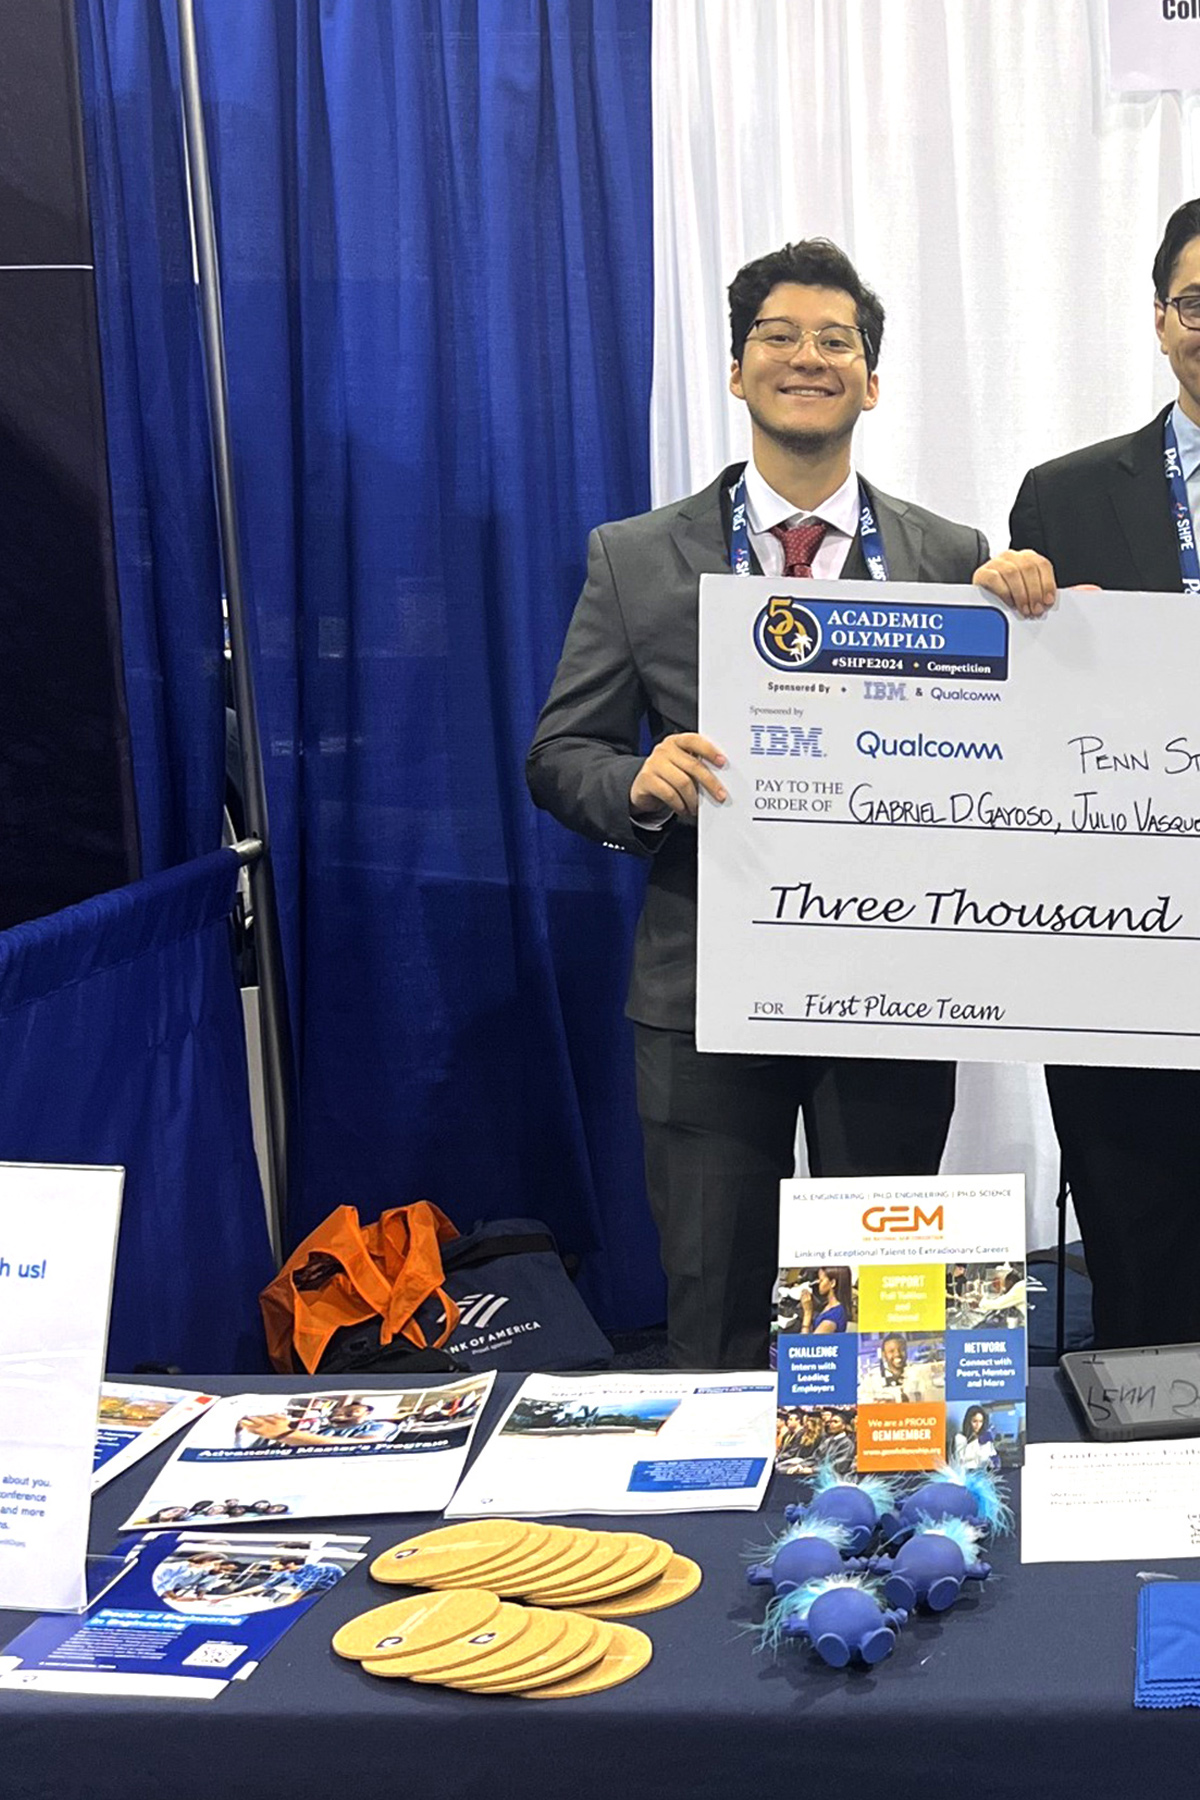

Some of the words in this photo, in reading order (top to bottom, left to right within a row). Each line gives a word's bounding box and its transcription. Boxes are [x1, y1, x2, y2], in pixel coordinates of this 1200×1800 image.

[1177, 519, 1194, 550] SHPE
[827, 610, 944, 630] ACADEMIC
[831, 630, 946, 650] OLYMPIAD
[831, 657, 903, 670] #SHPE2024
[927, 661, 991, 674] Competition
[768, 682, 816, 693] Sponsored
[819, 684, 830, 694] By
[863, 681, 907, 700] IBM
[915, 688, 923, 697] &
[931, 687, 1001, 701] Qualcomm
[750, 705, 793, 716] Sponsored
[750, 724, 824, 757] IBM
[857, 730, 1003, 760] Qualcomm
[1068, 736, 1149, 774] PENN
[755, 779, 785, 791] PAY
[787, 781, 809, 793] TO
[812, 782, 843, 794] THE
[755, 799, 809, 812] ORDER
[811, 800, 832, 812] OF
[849, 783, 946, 824] GABRIEL
[1071, 791, 1127, 832] JULIO
[770, 882, 916, 923] Three
[924, 888, 1184, 933] Thousand
[753, 1001, 784, 1015] FOR
[805, 993, 861, 1019] First
[864, 996, 933, 1020] Place
[936, 999, 1006, 1022] Team
[862, 1205, 944, 1233] GEM
[795, 1249, 826, 1259] Linking
[828, 1248, 879, 1258] Exceptional
[880, 1247, 906, 1256] Talent
[976, 1246, 1009, 1254] Careers
[18, 1260, 47, 1279] us!
[882, 1275, 925, 1288] SUPPORT
[469, 1336, 486, 1347] OF
[488, 1321, 541, 1342] AMERICA
[789, 1346, 838, 1358] CHALLENGE
[964, 1341, 1007, 1353] NETWORK
[791, 1362, 817, 1371] Intern
[818, 1361, 836, 1370] with
[959, 1357, 992, 1367] Connect
[993, 1357, 1012, 1366] with
[797, 1373, 830, 1383] Leading
[981, 1367, 1015, 1376] Mentors
[791, 1384, 835, 1394] Employers
[967, 1378, 982, 1387] and
[983, 1378, 1005, 1387] More
[868, 1419, 882, 1427] We
[905, 1417, 937, 1426] PROUD
[872, 1430, 891, 1441] GEM
[892, 1429, 931, 1441] MEMBER
[3, 1474, 29, 1485] about
[0, 1505, 18, 1515] and
[21, 1508, 46, 1517] more
[106, 1618, 187, 1630] Engineering
[163, 1613, 242, 1625] Engineering
